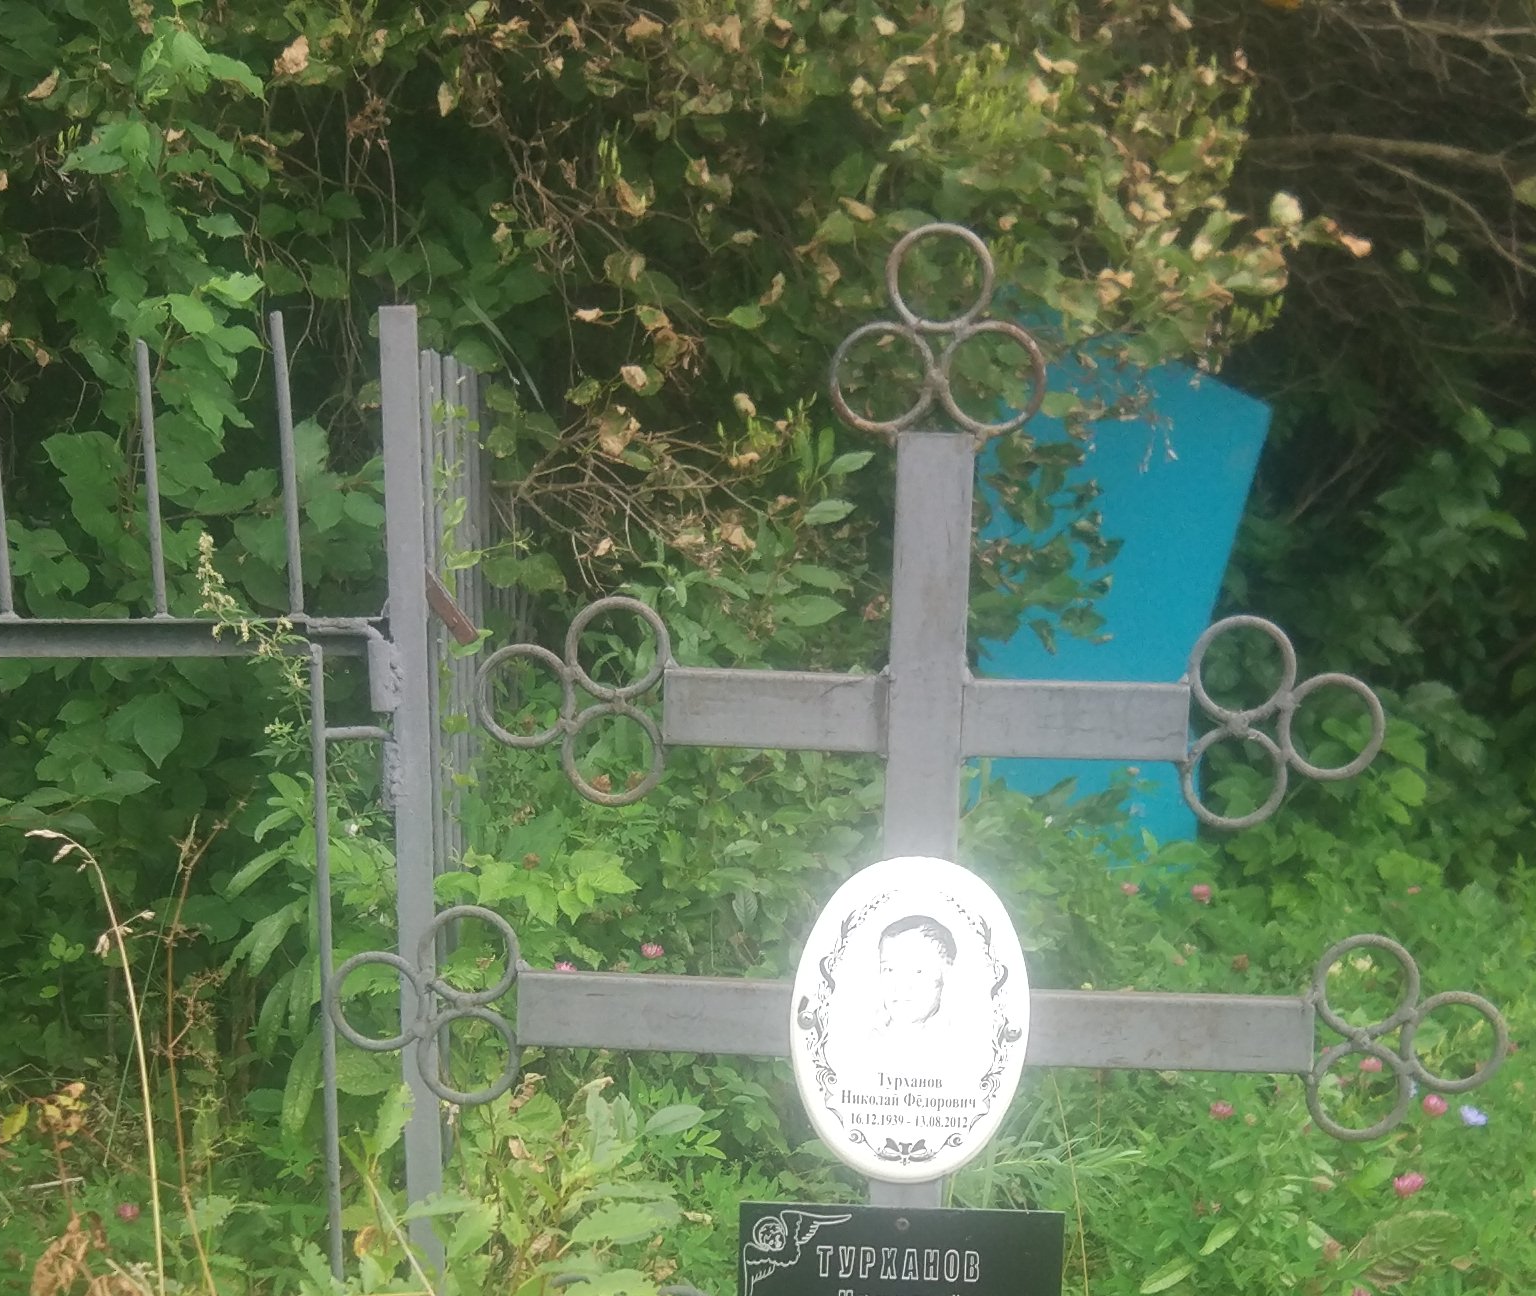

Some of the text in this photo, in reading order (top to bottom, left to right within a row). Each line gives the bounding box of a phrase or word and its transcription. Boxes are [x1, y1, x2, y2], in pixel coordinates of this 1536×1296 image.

[877, 1072, 943, 1090] Турханов
[841, 1089, 976, 1112] Николай Фёдорович
[850, 1112, 904, 1126] 16.12.1939
[915, 1115, 969, 1129] 13.08.2012
[816, 1245, 980, 1283] ТУРХАНОВ
